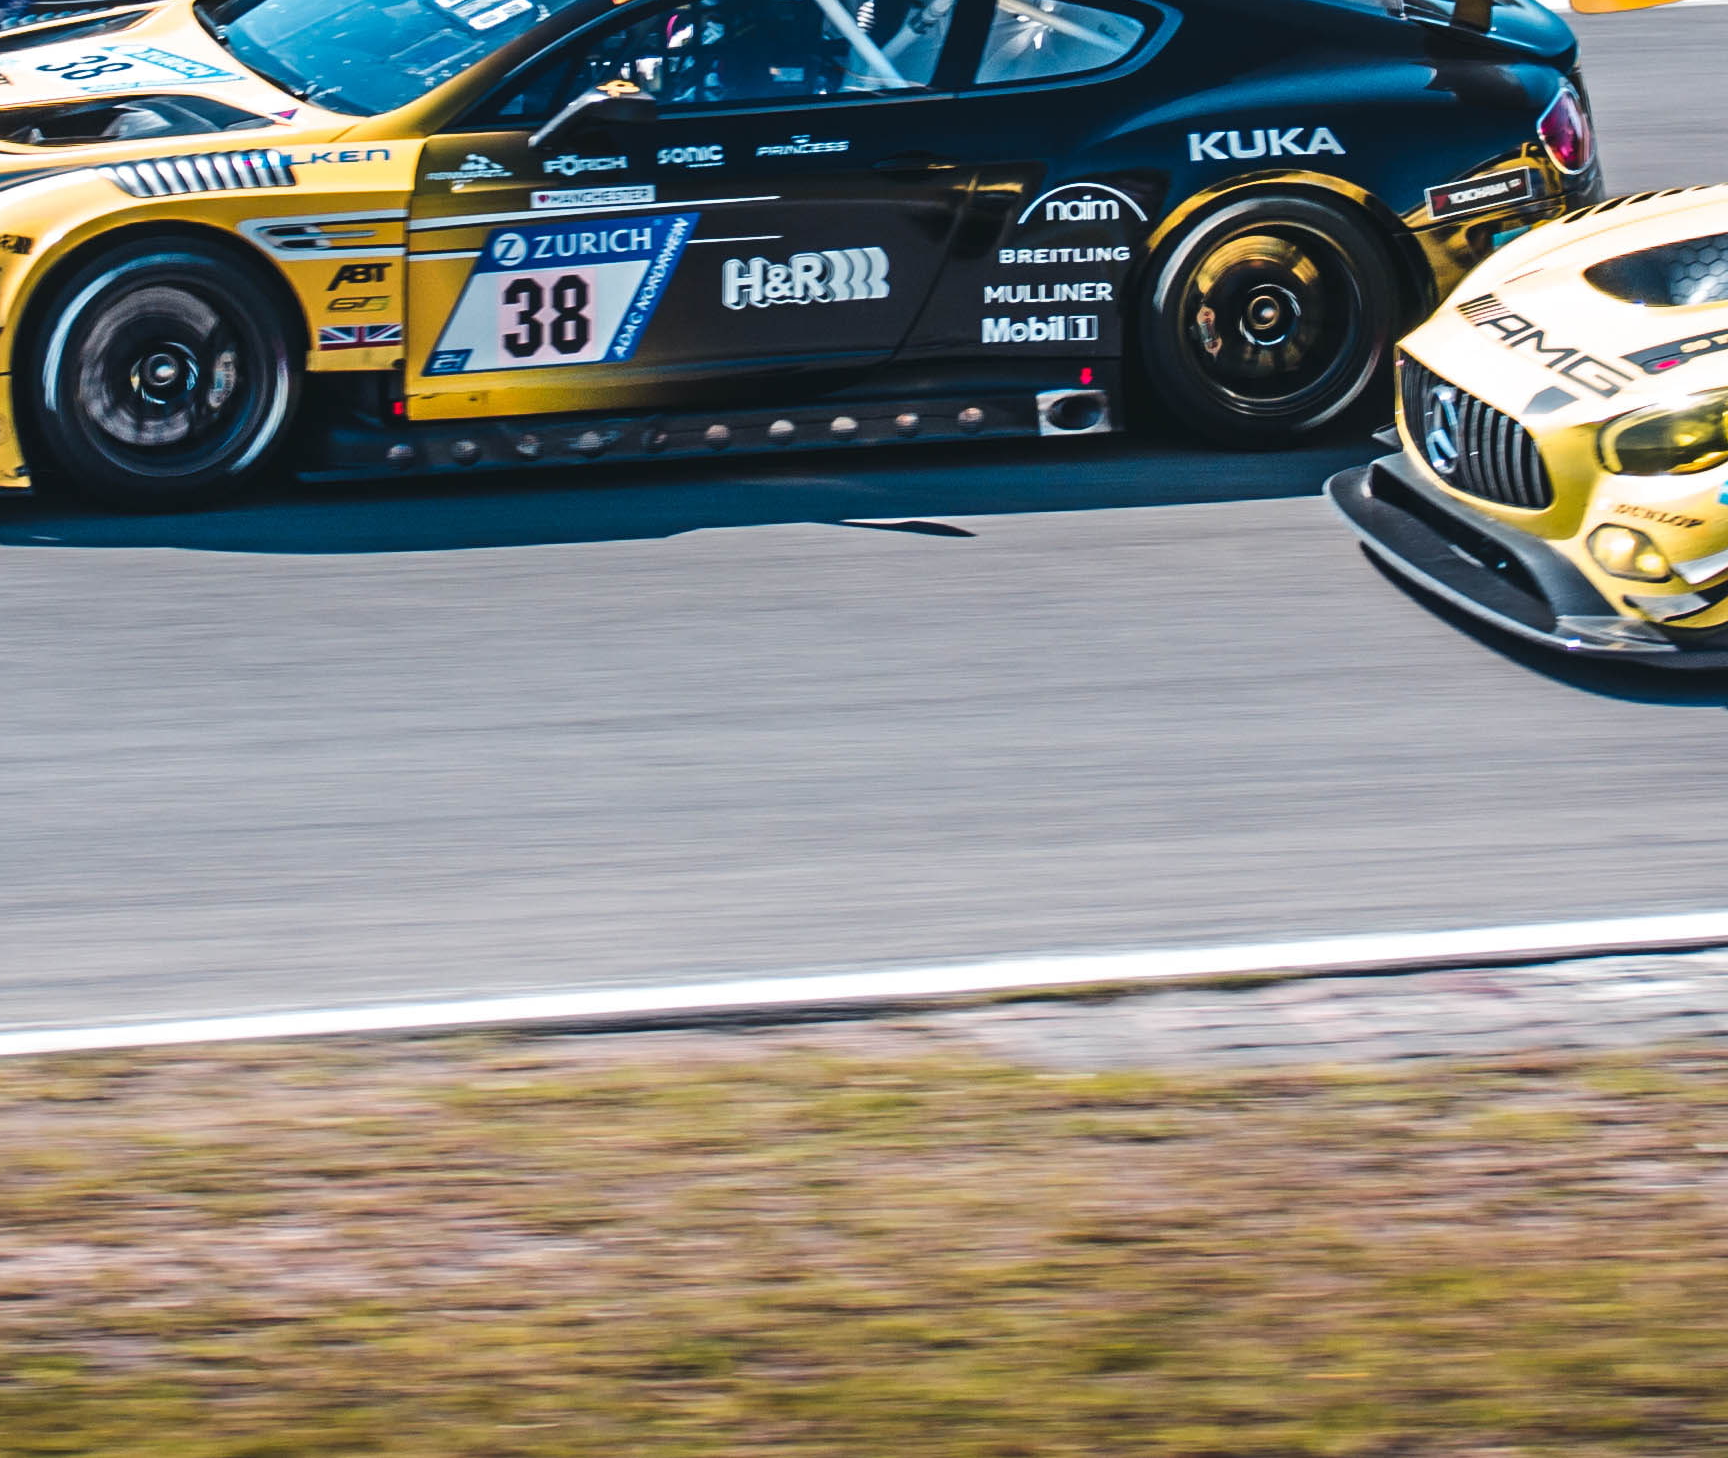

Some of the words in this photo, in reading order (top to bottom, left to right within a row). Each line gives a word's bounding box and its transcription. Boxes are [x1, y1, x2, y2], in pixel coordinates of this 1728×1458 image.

[35, 54, 134, 80] 38
[1186, 126, 1347, 162] KUKA
[550, 186, 649, 206] MANCHESTER
[1044, 194, 1120, 222] naim
[532, 227, 653, 260] ZURICH
[998, 246, 1131, 264] BREITLING
[325, 262, 393, 292] ABT
[722, 251, 840, 311] H&R
[983, 281, 1114, 305] MULLINER
[501, 273, 591, 360] 38
[981, 315, 1066, 343] Mobil
[611, 310, 644, 360] ADAC
